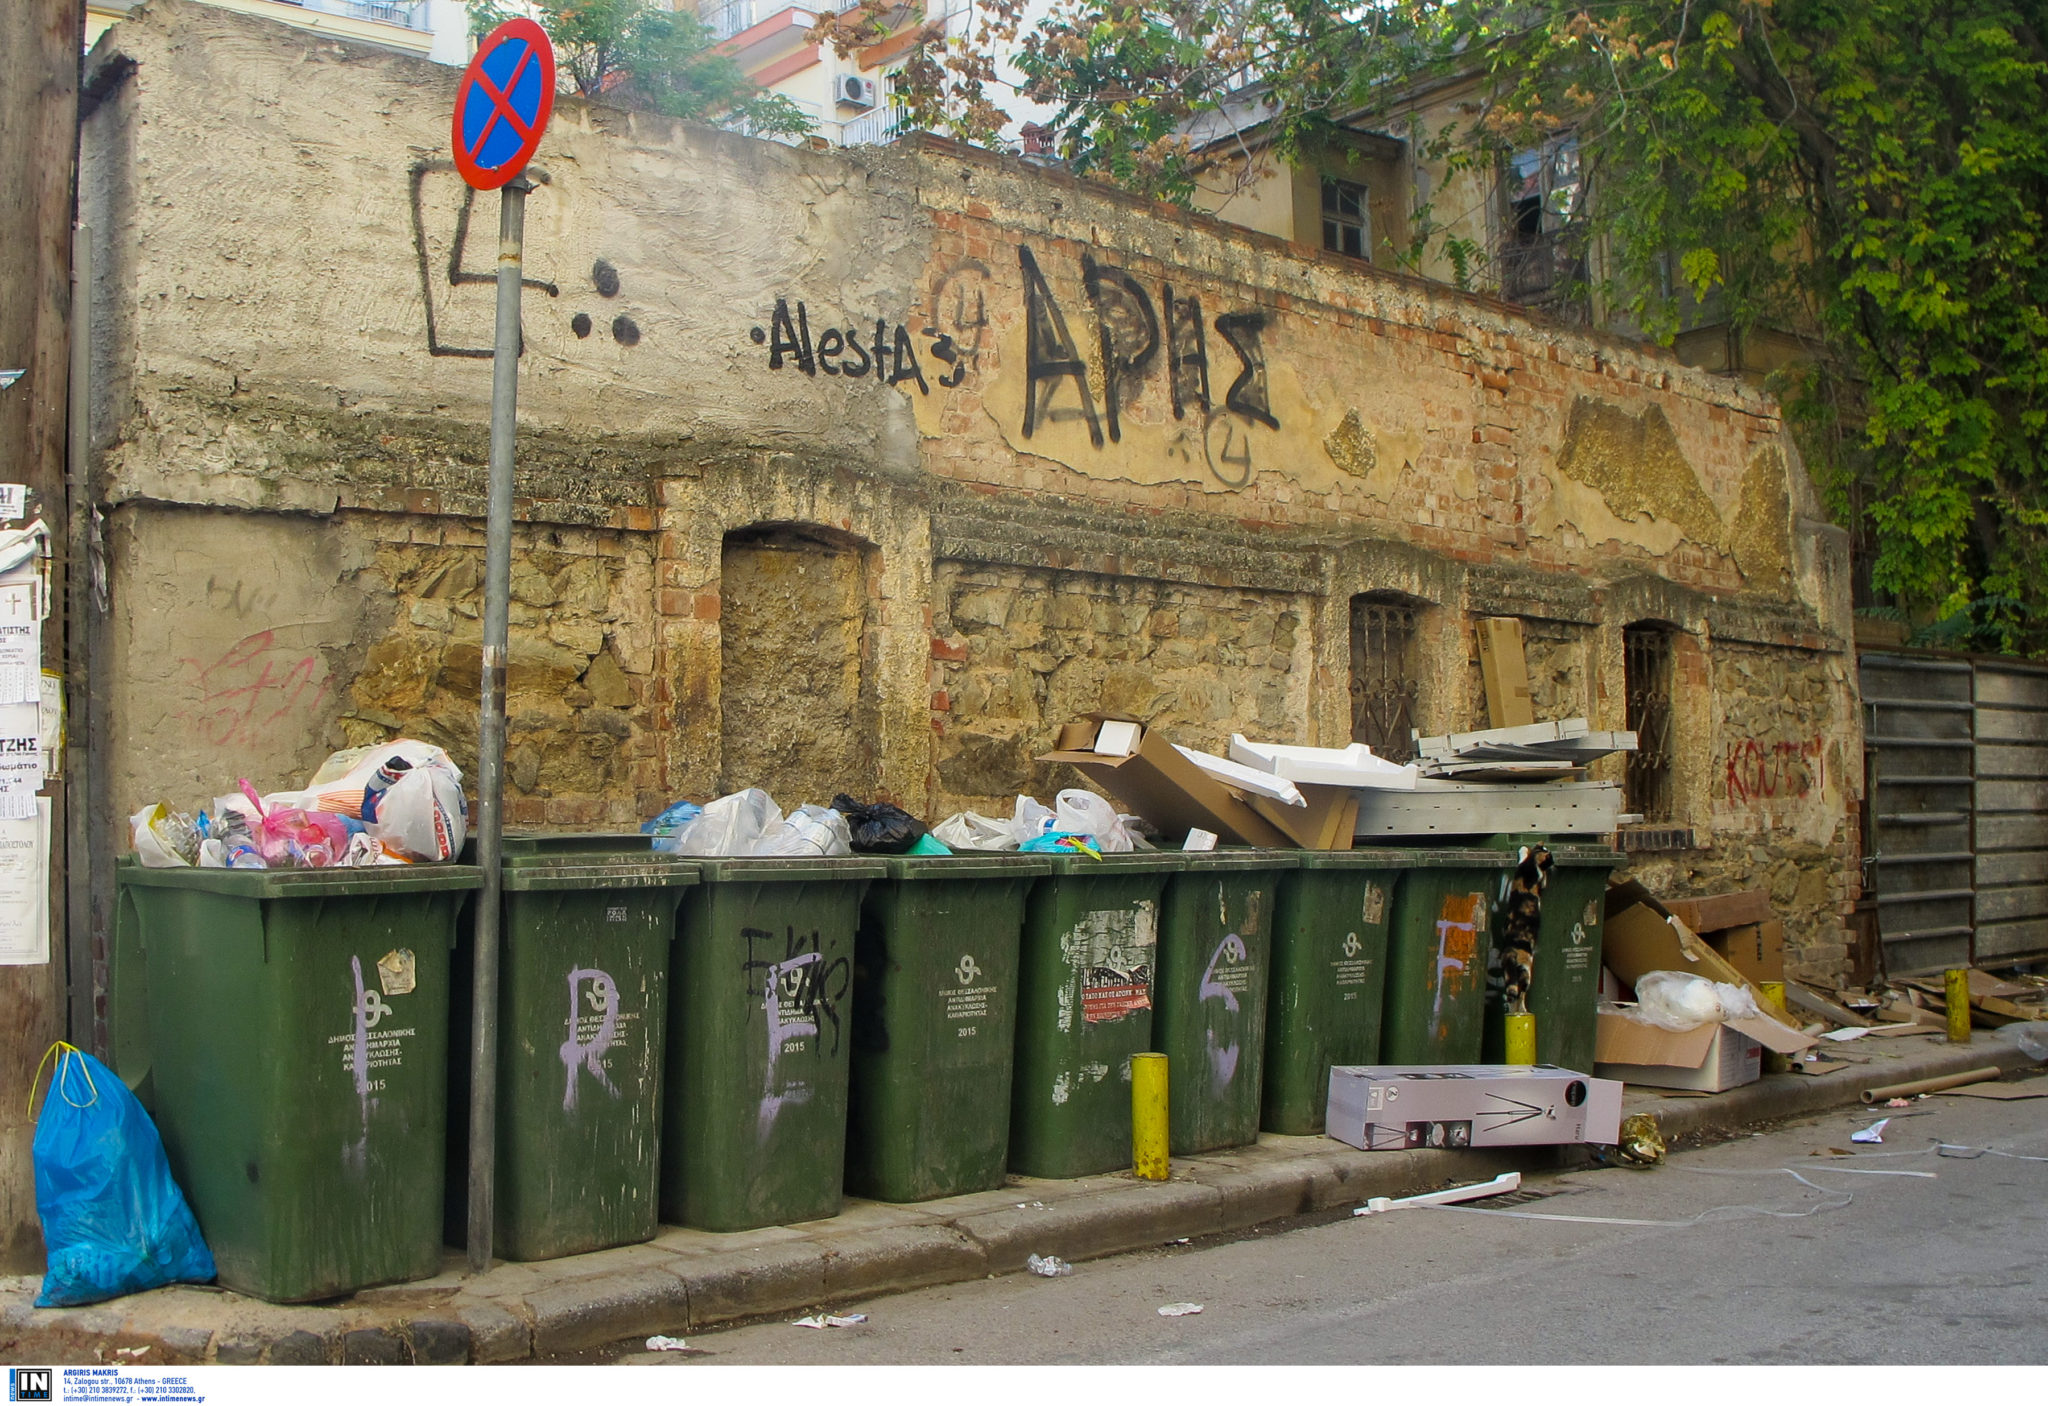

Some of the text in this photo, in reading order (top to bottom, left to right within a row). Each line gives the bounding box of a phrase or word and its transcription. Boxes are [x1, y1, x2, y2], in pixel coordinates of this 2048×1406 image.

[958, 1026, 976, 1037] 2015
[784, 1042, 805, 1053] 2015
[366, 1079, 386, 1092] 015
